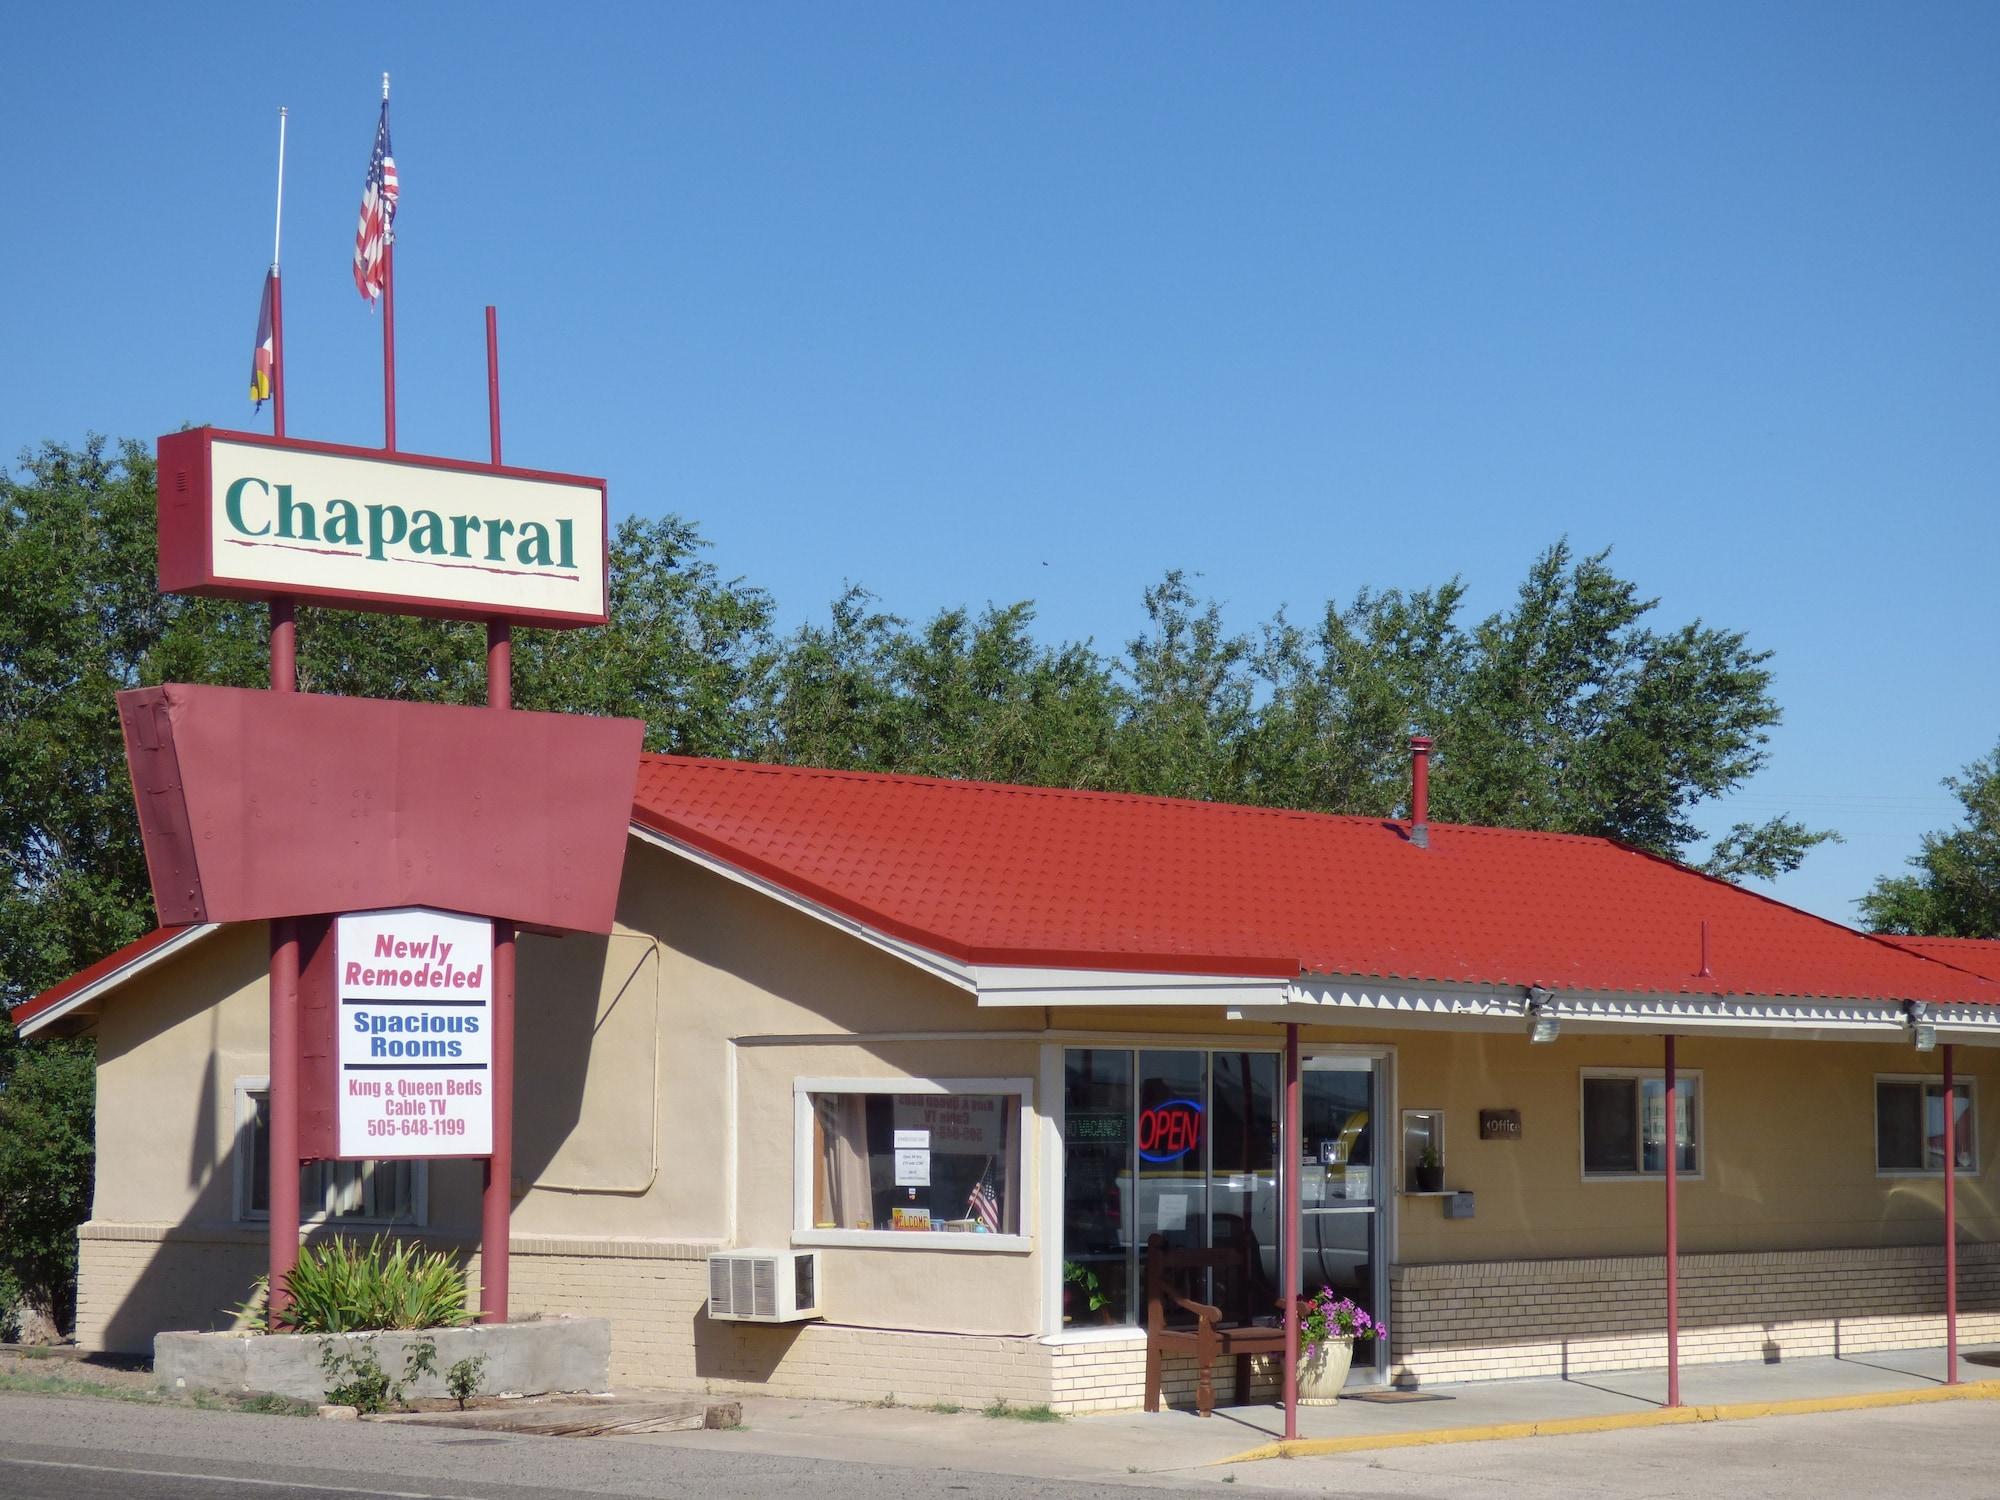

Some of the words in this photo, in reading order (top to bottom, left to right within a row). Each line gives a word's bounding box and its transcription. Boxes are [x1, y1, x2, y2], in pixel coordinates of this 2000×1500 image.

[224, 477, 579, 569] Chaparral
[374, 934, 453, 967] Newly
[345, 961, 483, 989] Remodeled
[354, 1011, 480, 1035] Spacious
[371, 1037, 463, 1058] Rooms
[349, 1079, 381, 1098] King
[385, 1081, 395, 1096] &
[398, 1079, 443, 1098] Queen
[446, 1079, 483, 1097] Beds
[385, 1099, 426, 1116] Cable
[429, 1099, 447, 1116] TV
[368, 1119, 465, 1136] 505-648-1199
[1079, 1119, 1123, 1136] VACANCY
[1139, 1110, 1199, 1150] OPEN
[1491, 1119, 1520, 1132] Office
[894, 1215, 929, 1229] WELCOME
